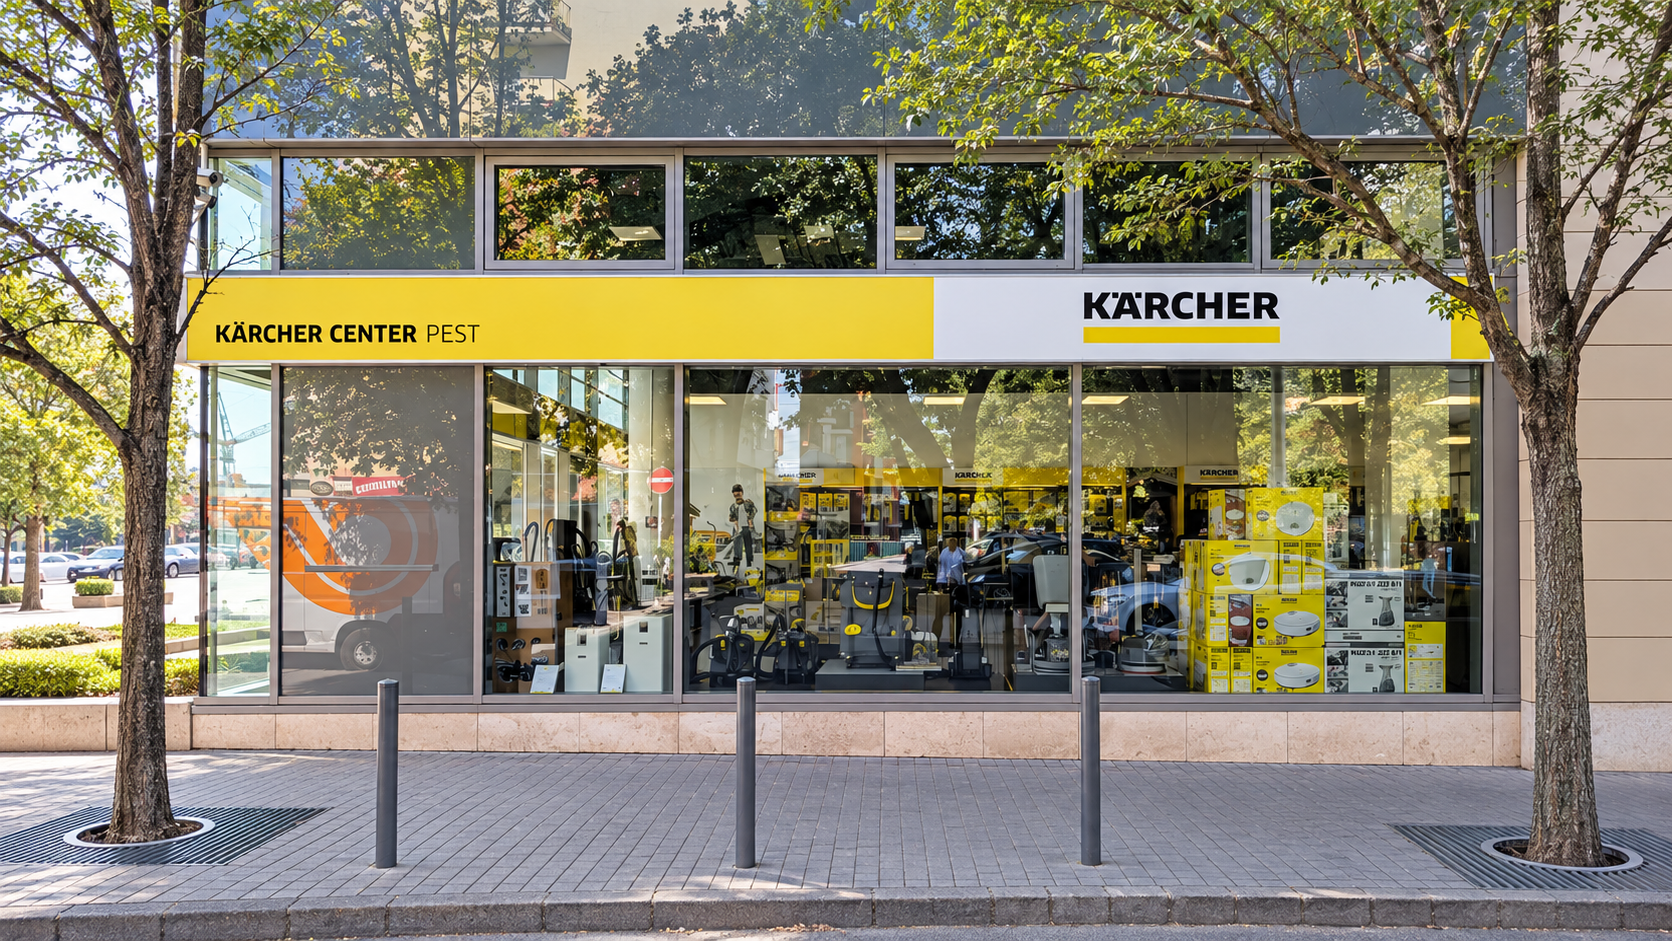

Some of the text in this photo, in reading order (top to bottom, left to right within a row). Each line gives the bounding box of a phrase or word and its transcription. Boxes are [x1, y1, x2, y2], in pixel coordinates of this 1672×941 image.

[1083, 291, 1280, 320] KÄRCHER
[215, 321, 480, 343] KÄRCHER CENTER PEST
